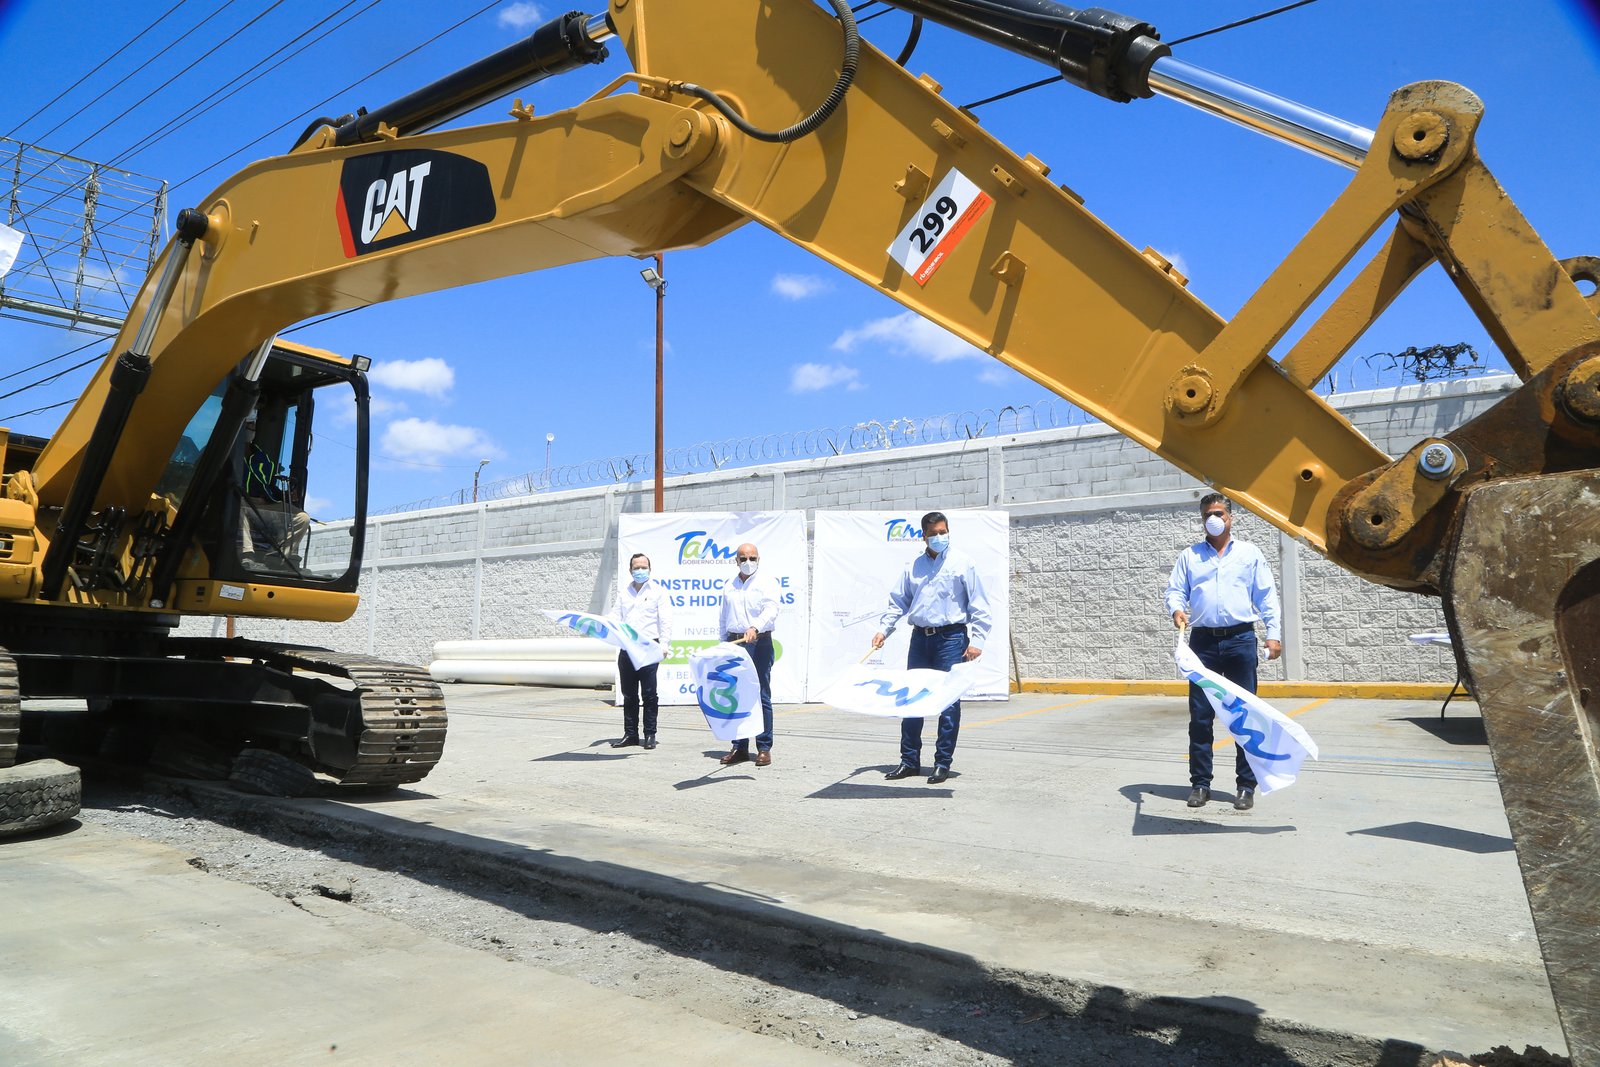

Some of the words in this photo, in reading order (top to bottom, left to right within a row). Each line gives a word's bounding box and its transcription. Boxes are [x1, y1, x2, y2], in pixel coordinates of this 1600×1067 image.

[361, 161, 431, 244] CAT
[909, 196, 957, 254] 299
[775, 577, 789, 588] E
[684, 627, 721, 636] INVERS
